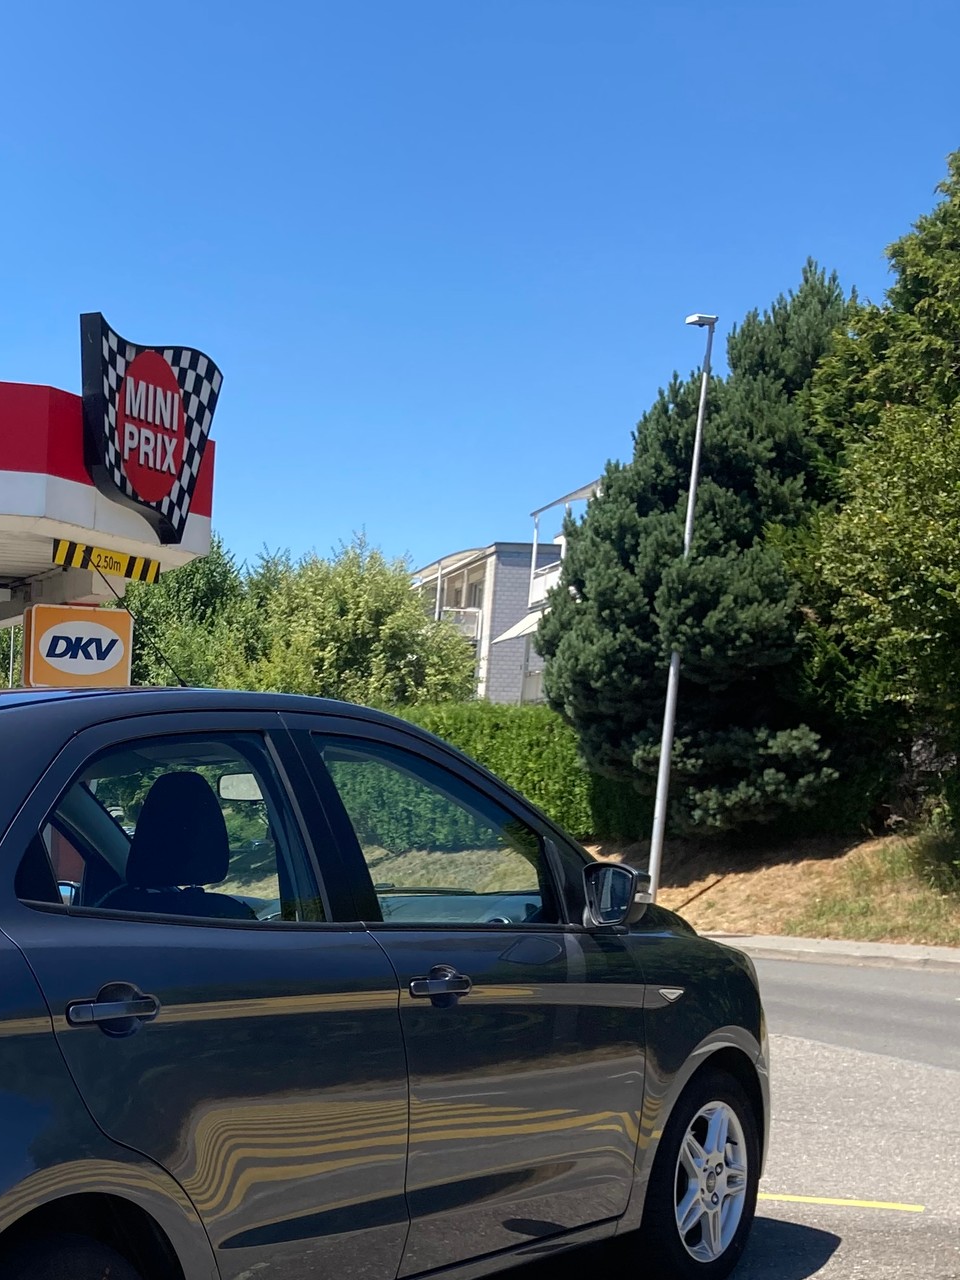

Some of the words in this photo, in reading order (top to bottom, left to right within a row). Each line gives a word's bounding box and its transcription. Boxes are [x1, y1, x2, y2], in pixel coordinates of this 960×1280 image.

[124, 375, 180, 432] MINI
[123, 422, 178, 476] PRIX
[45, 635, 119, 661] DKV
